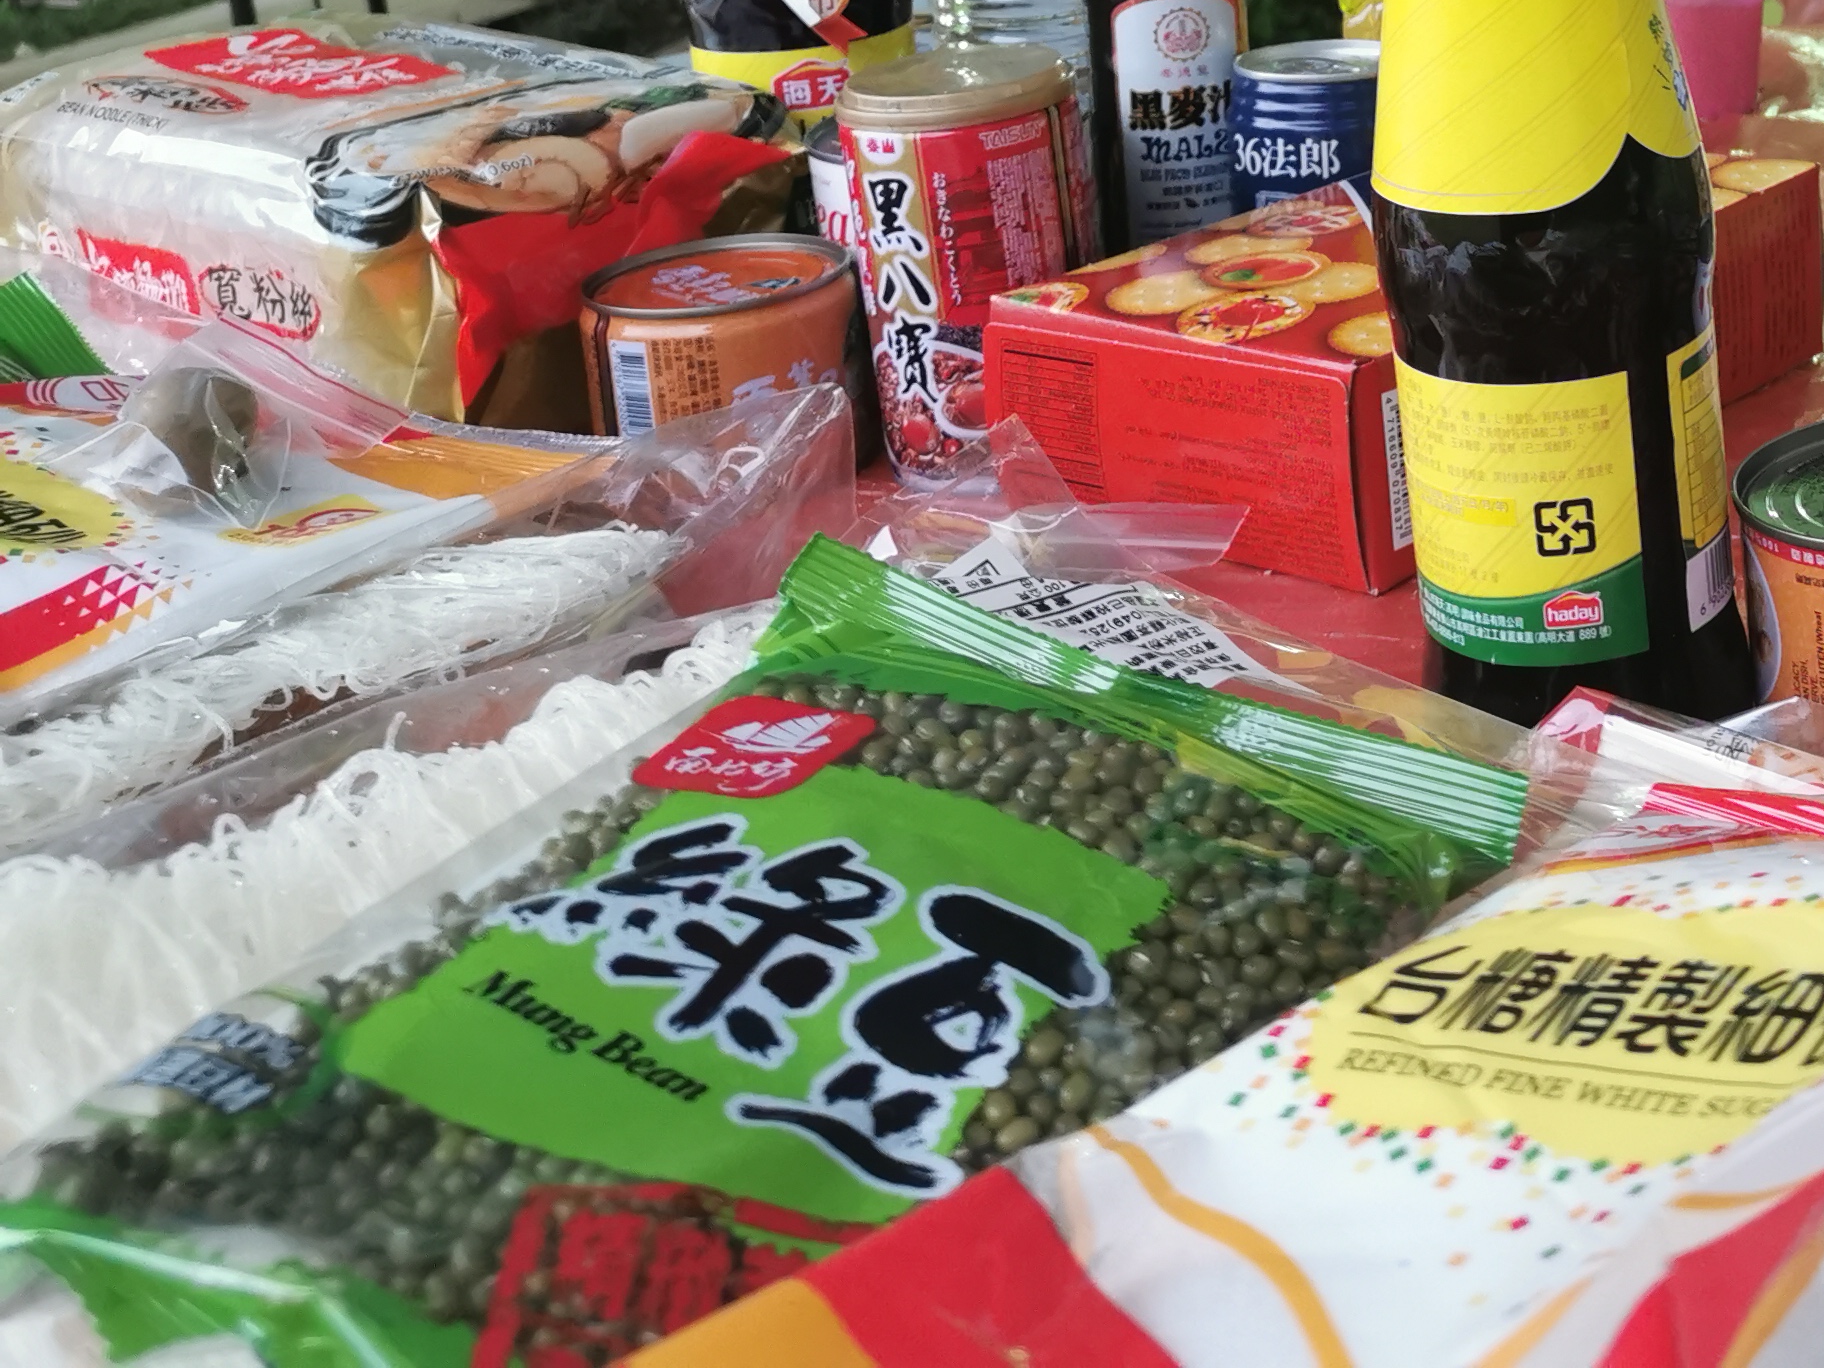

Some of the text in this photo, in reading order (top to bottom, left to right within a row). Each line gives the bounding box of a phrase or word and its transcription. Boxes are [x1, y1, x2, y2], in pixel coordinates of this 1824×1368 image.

[781, 71, 845, 109] 海天
[1233, 135, 1342, 180] 36法郎
[206, 264, 316, 332] 寬粉絲
[865, 177, 940, 404] 黑八寶
[1546, 604, 1600, 625] haday
[466, 969, 712, 1105] Mung Bean
[510, 820, 1108, 1192] 綠豆
[1334, 1046, 1484, 1089] REFINED
[1483, 1066, 1572, 1101] FINE
[1573, 1079, 1704, 1119] WHITE
